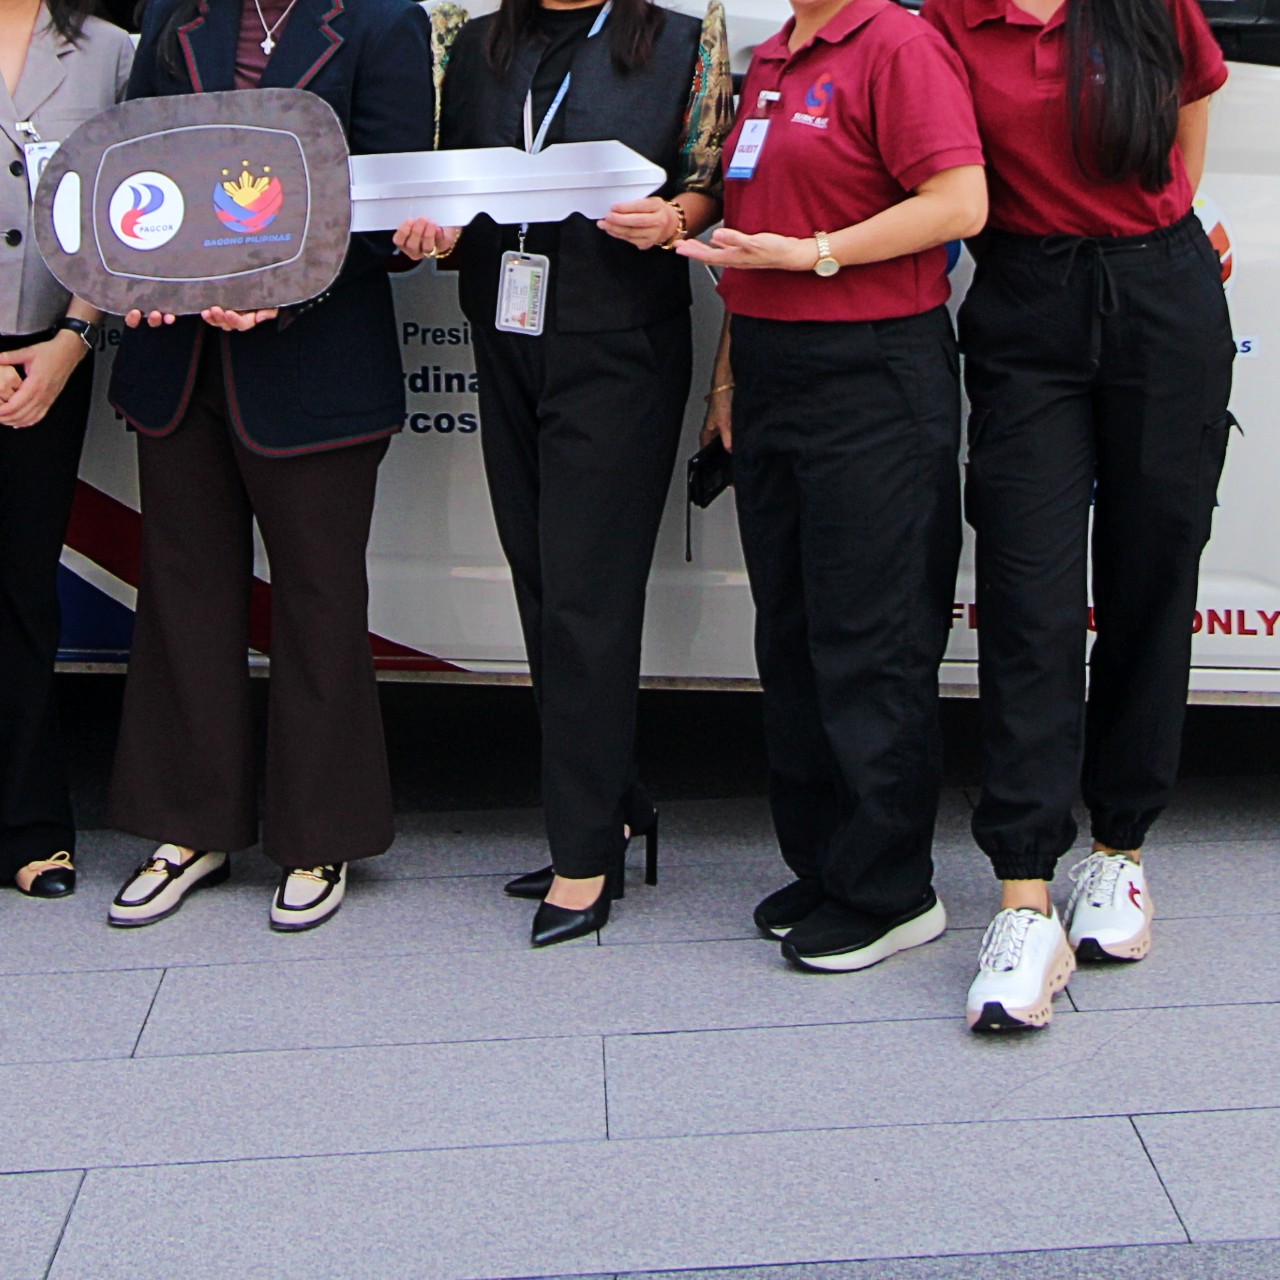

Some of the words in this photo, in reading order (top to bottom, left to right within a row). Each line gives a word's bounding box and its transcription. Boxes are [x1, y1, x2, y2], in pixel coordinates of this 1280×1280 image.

[139, 224, 174, 233] PAGCOR
[245, 233, 292, 244] PILIPINAS
[402, 321, 470, 346] Presi
[404, 412, 478, 434] cos
